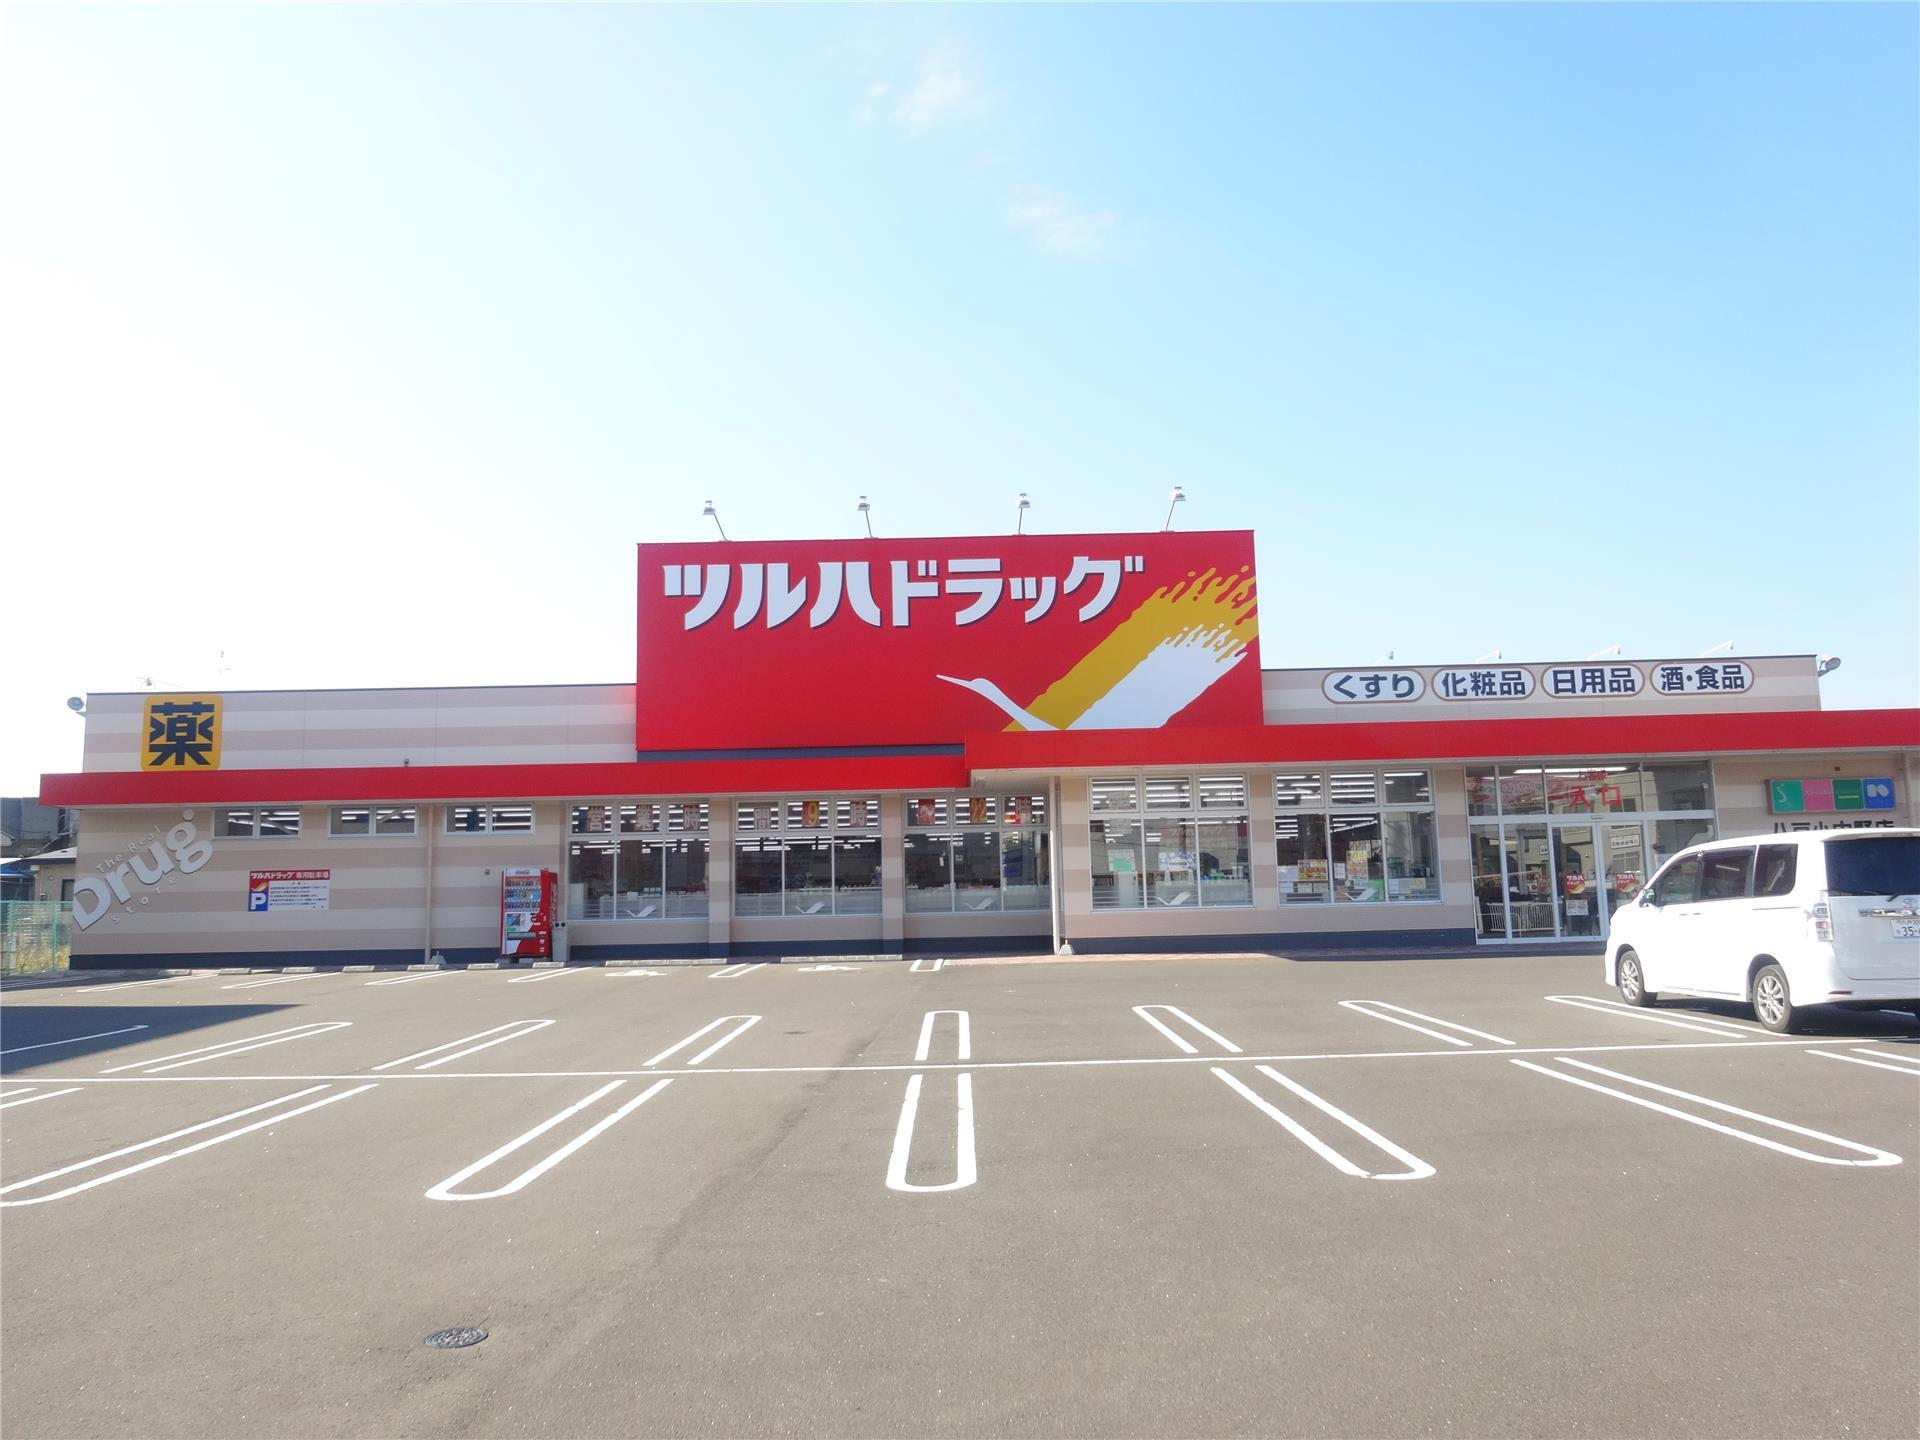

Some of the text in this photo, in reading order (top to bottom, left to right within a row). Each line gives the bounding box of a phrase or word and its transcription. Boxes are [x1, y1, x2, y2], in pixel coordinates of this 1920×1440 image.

[663, 556, 1143, 630] ツルハドラッグ
[1333, 674, 1415, 699] くすり
[1441, 671, 1526, 697] 化粧品
[1552, 667, 1636, 694] 日用品
[149, 702, 215, 766] 薬
[1568, 785, 1622, 812] 入口
[96, 825, 161, 873] The Real
[73, 808, 213, 931] Drug
[113, 876, 177, 924] store
[250, 892, 267, 910] P
